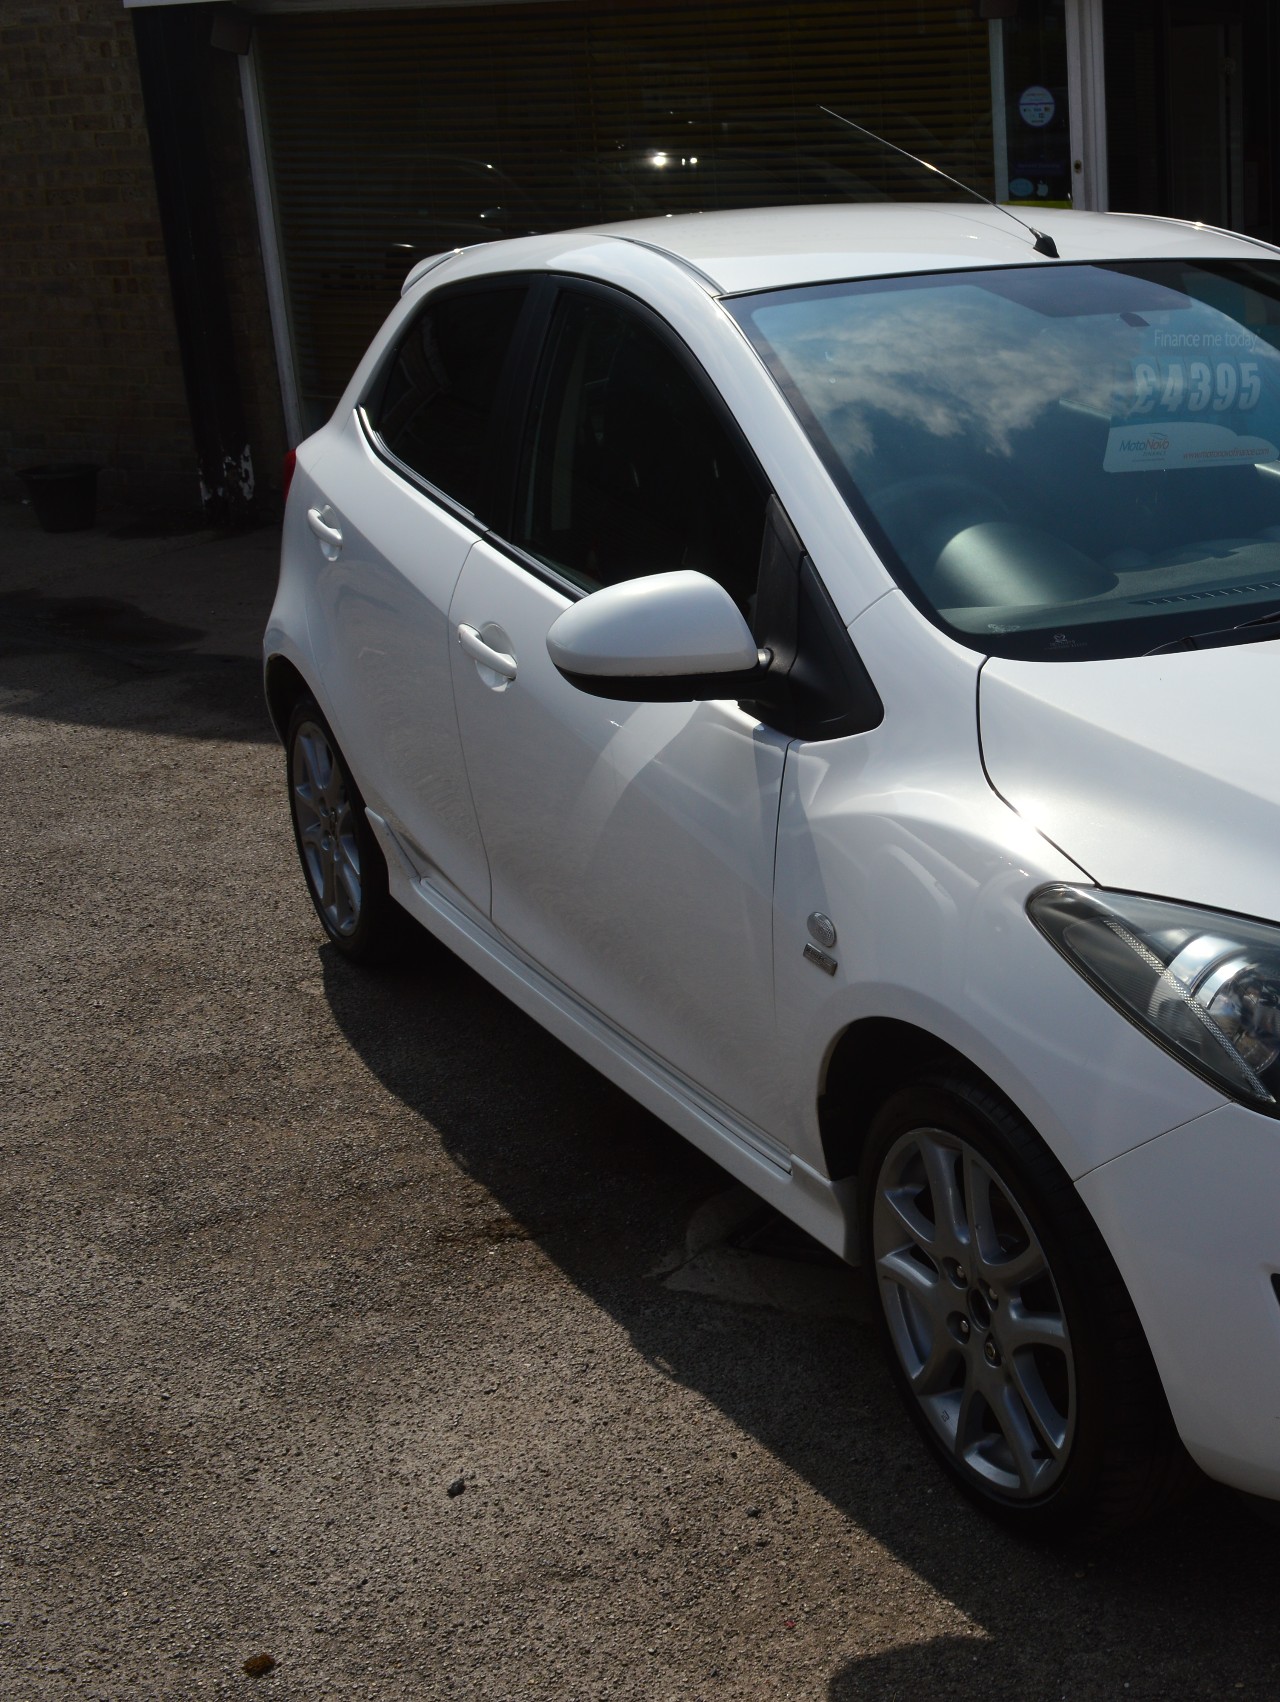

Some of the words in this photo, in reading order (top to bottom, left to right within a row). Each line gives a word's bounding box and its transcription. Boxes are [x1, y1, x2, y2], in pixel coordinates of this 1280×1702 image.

[1154, 329, 1200, 347] Finance
[1203, 334, 1222, 347] me
[1134, 361, 1262, 414] £4395
[1119, 439, 1170, 451] MotoNovo
